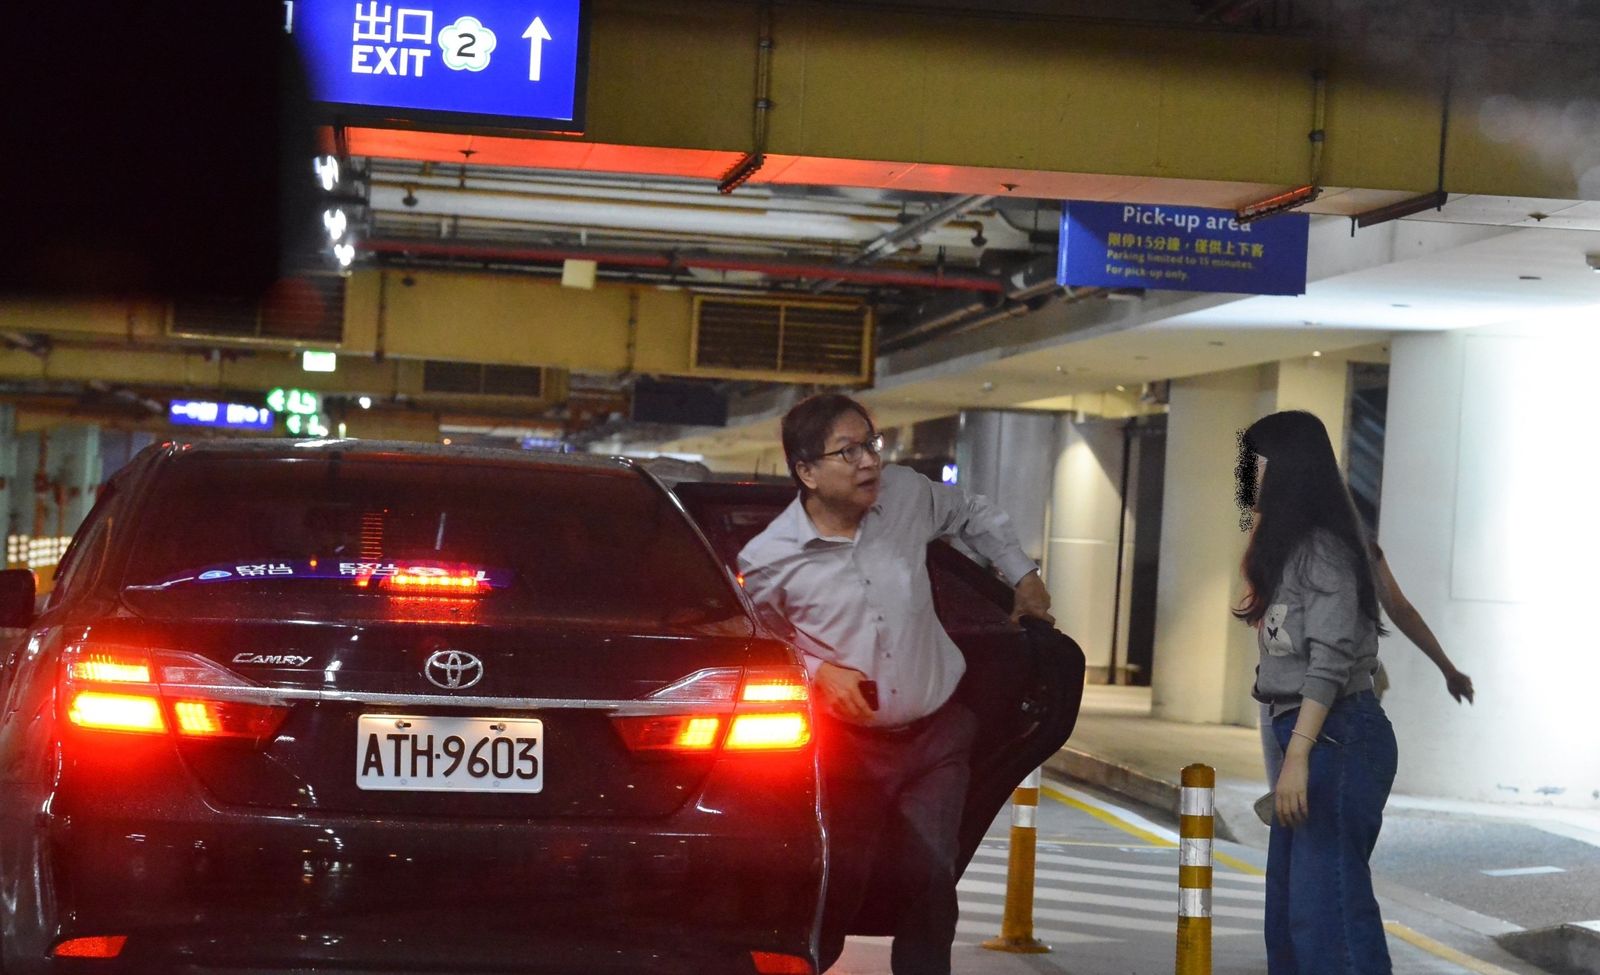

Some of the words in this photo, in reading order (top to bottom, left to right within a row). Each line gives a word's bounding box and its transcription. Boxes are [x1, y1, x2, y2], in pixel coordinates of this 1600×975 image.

[353, 1, 433, 44] 出口
[457, 33, 476, 58] 2
[352, 45, 431, 77] EXIT
[1123, 205, 1199, 233] Pick-up
[1206, 215, 1251, 232] area
[1107, 249, 1145, 264] Parking
[232, 652, 312, 666] CAMRY
